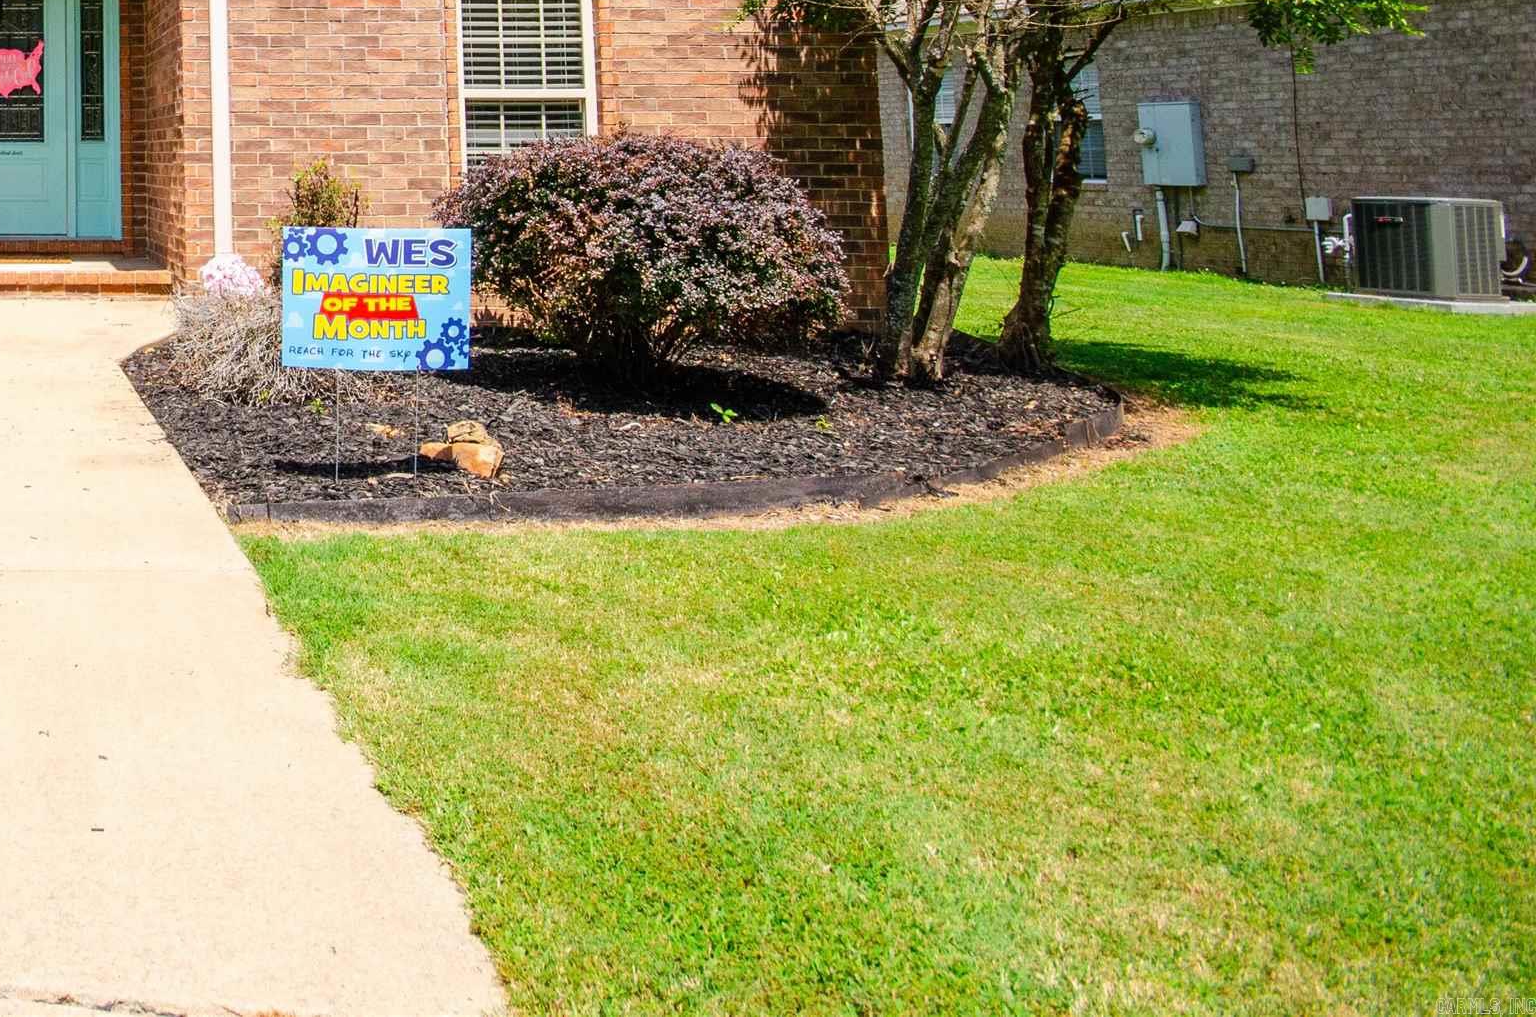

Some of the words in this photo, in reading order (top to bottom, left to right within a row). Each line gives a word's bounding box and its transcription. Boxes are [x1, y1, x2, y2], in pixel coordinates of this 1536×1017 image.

[364, 238, 458, 267] WES
[292, 269, 449, 295] IMAGINEER
[322, 297, 358, 312] OF
[365, 297, 412, 311] THE
[313, 313, 427, 340] MONTH
[288, 345, 324, 356] REACH
[331, 347, 354, 358] FOR
[362, 349, 382, 359] THE
